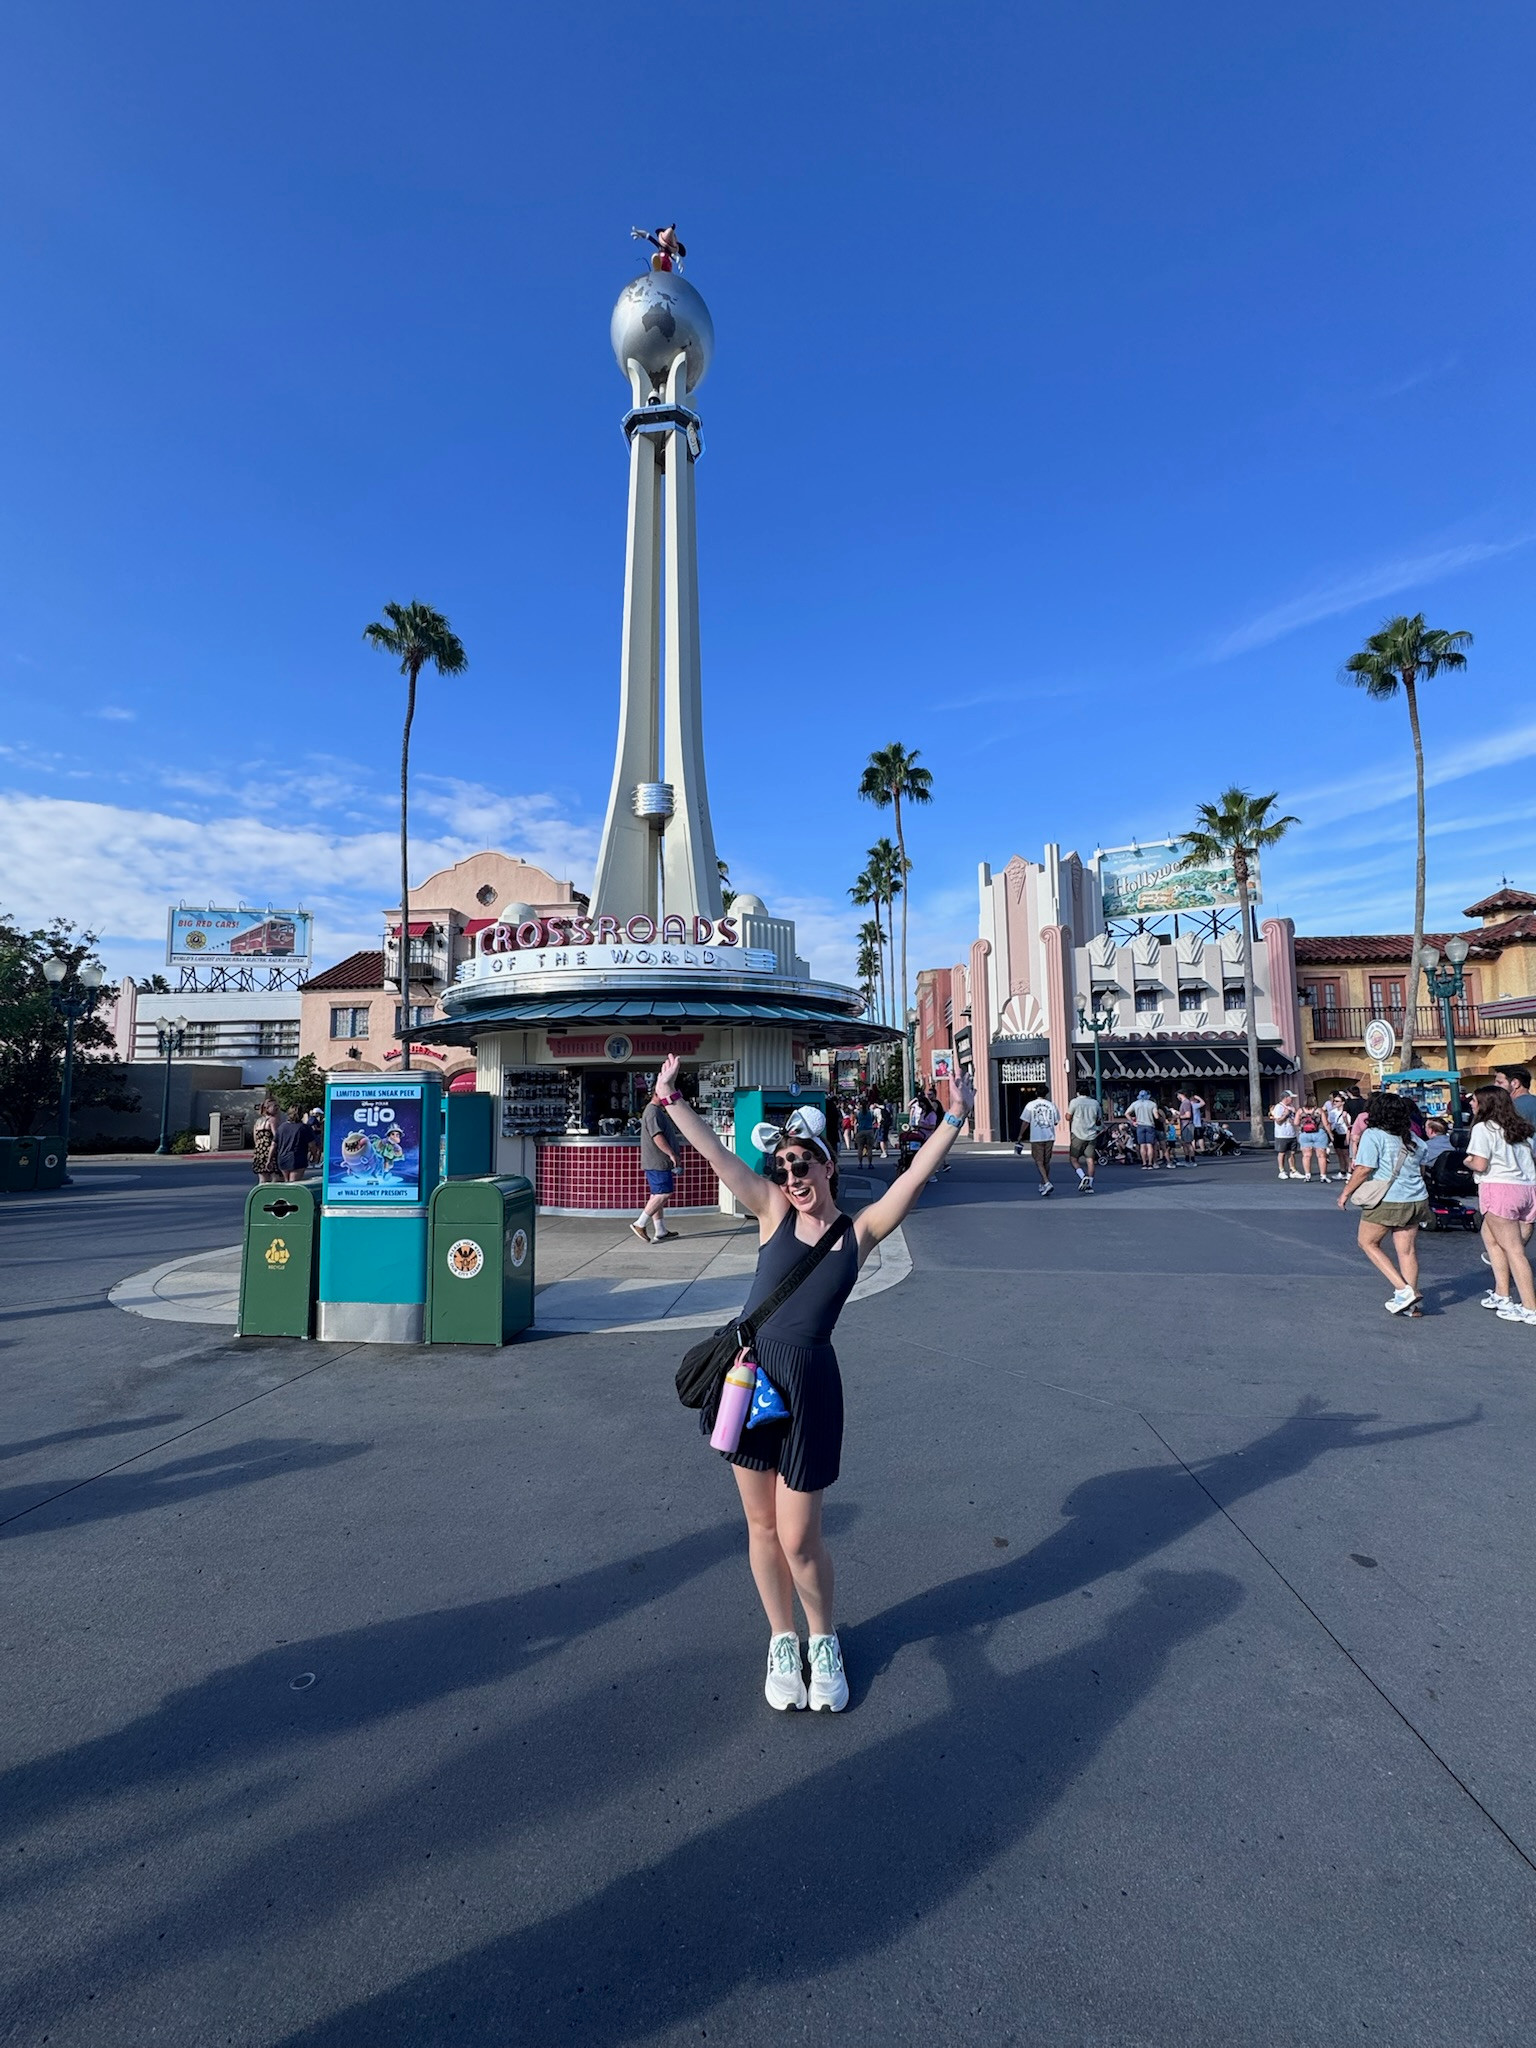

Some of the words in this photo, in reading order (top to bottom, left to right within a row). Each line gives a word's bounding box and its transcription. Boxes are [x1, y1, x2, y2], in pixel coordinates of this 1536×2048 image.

[178, 919, 193, 927] BIG
[195, 920, 212, 928] RED
[215, 920, 240, 928] CARS!
[481, 914, 740, 955] CROSSROADS
[492, 956, 516, 972] OF
[536, 951, 588, 968] THE
[610, 949, 716, 964] WORLD
[378, 1089, 398, 1097] SNEAK
[399, 1089, 415, 1097] PEEK
